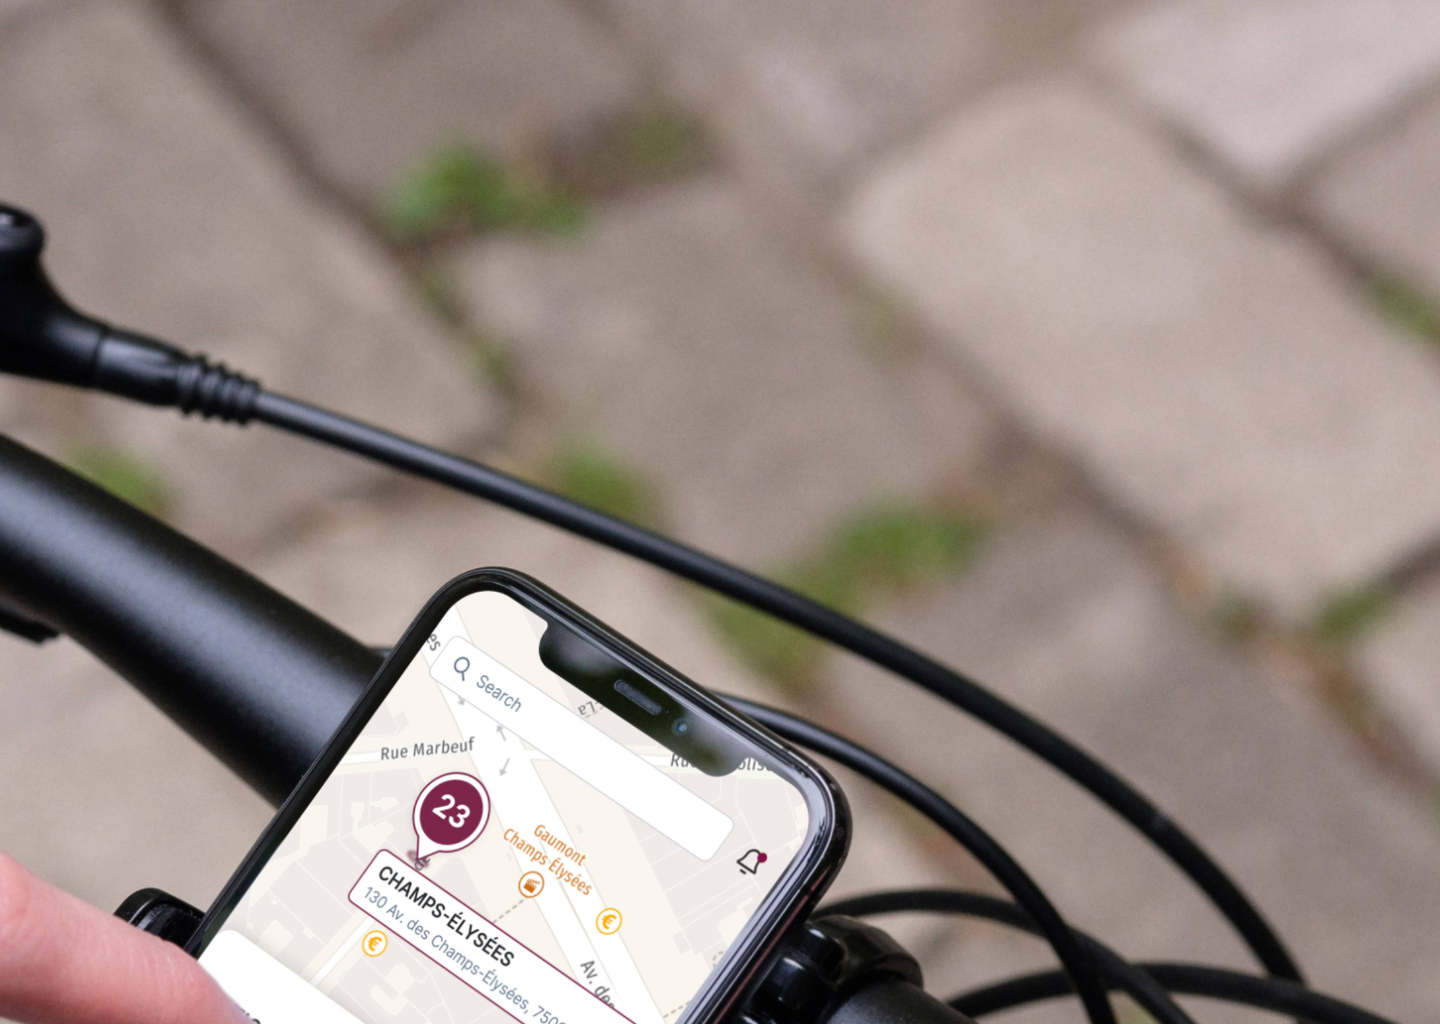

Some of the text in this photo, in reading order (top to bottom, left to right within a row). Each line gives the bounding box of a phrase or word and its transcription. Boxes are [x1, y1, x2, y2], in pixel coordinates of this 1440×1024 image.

[476, 674, 523, 713] Search
[379, 736, 475, 761] Rue Marbeuf
[671, 753, 697, 768] Ru
[432, 793, 471, 828] 23
[503, 828, 593, 896] Champs Élysées
[534, 824, 586, 866] Gaumont
[378, 865, 515, 967] CHAMPS-ÉLYSÉES
[363, 886, 388, 909] 130
[386, 903, 404, 924] Av.
[406, 915, 431, 940] des
[430, 934, 529, 1014] Champs-Élysées,
[580, 960, 598, 984] Av.
